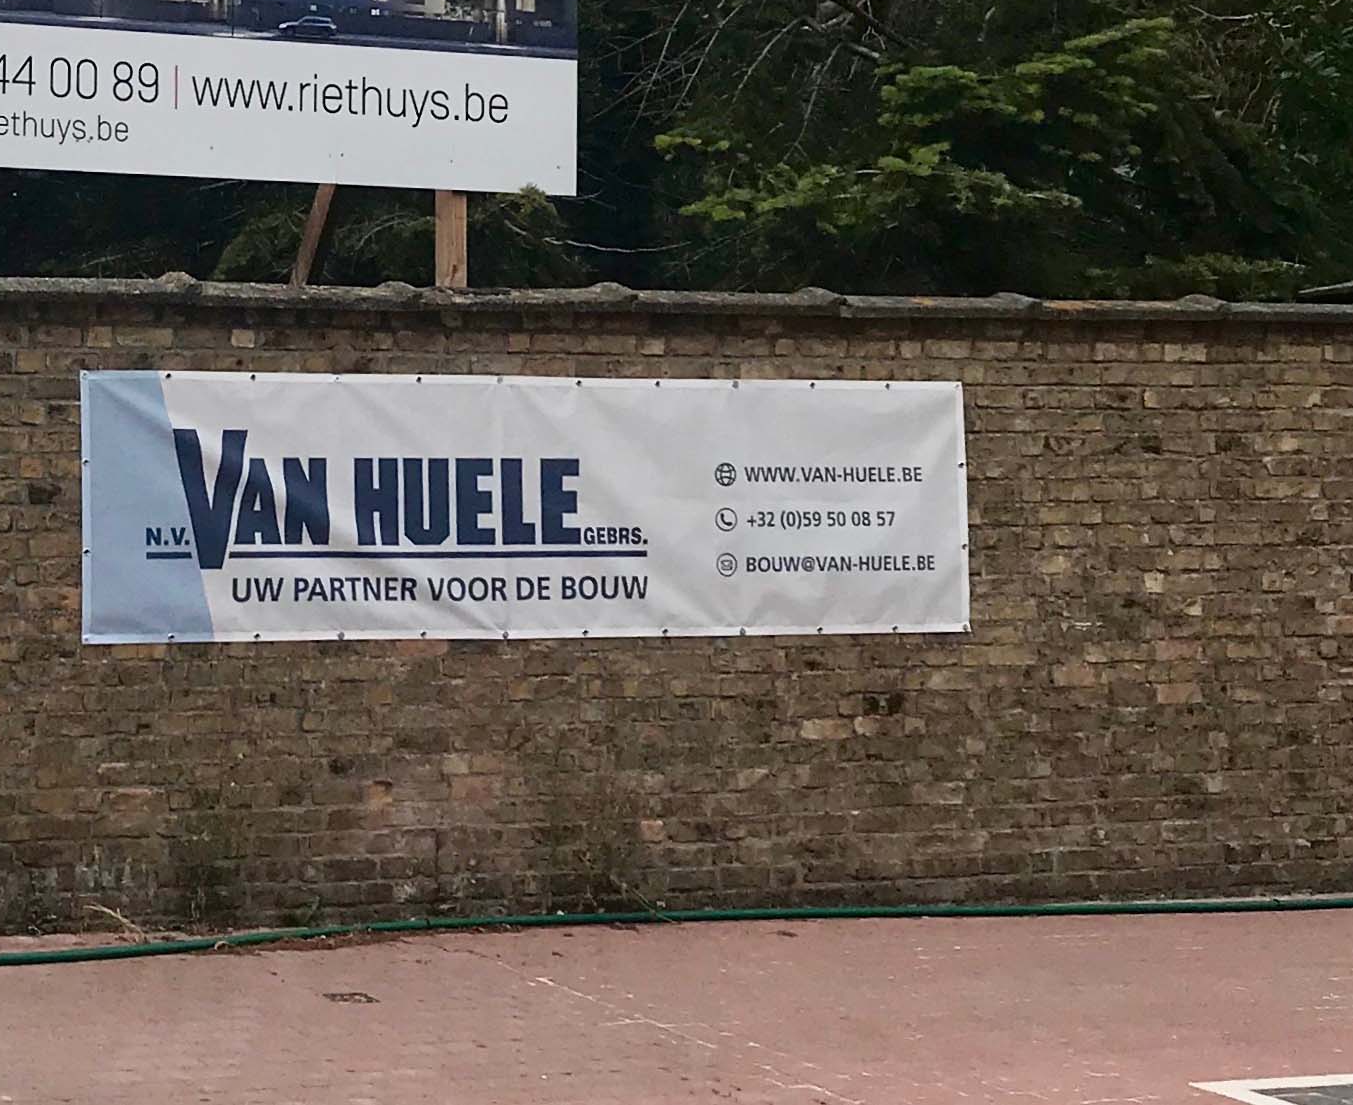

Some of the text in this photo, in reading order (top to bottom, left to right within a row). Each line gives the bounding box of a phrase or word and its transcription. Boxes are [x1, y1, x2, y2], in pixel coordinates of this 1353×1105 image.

[49, 58, 99, 100] 00
[112, 61, 160, 103] 89
[192, 72, 510, 128] www.riethuys.be
[744, 466, 923, 483] WWW.VAN-HUELE.BE
[145, 428, 648, 570] N.V. VAN HUELE GEBRS.
[746, 510, 896, 530] +32 (0)59 50 08 57
[746, 555, 936, 573] BOUW@VAN-HUELE.BE
[232, 575, 648, 603] UW PARTNER VOOR DE BOUW
